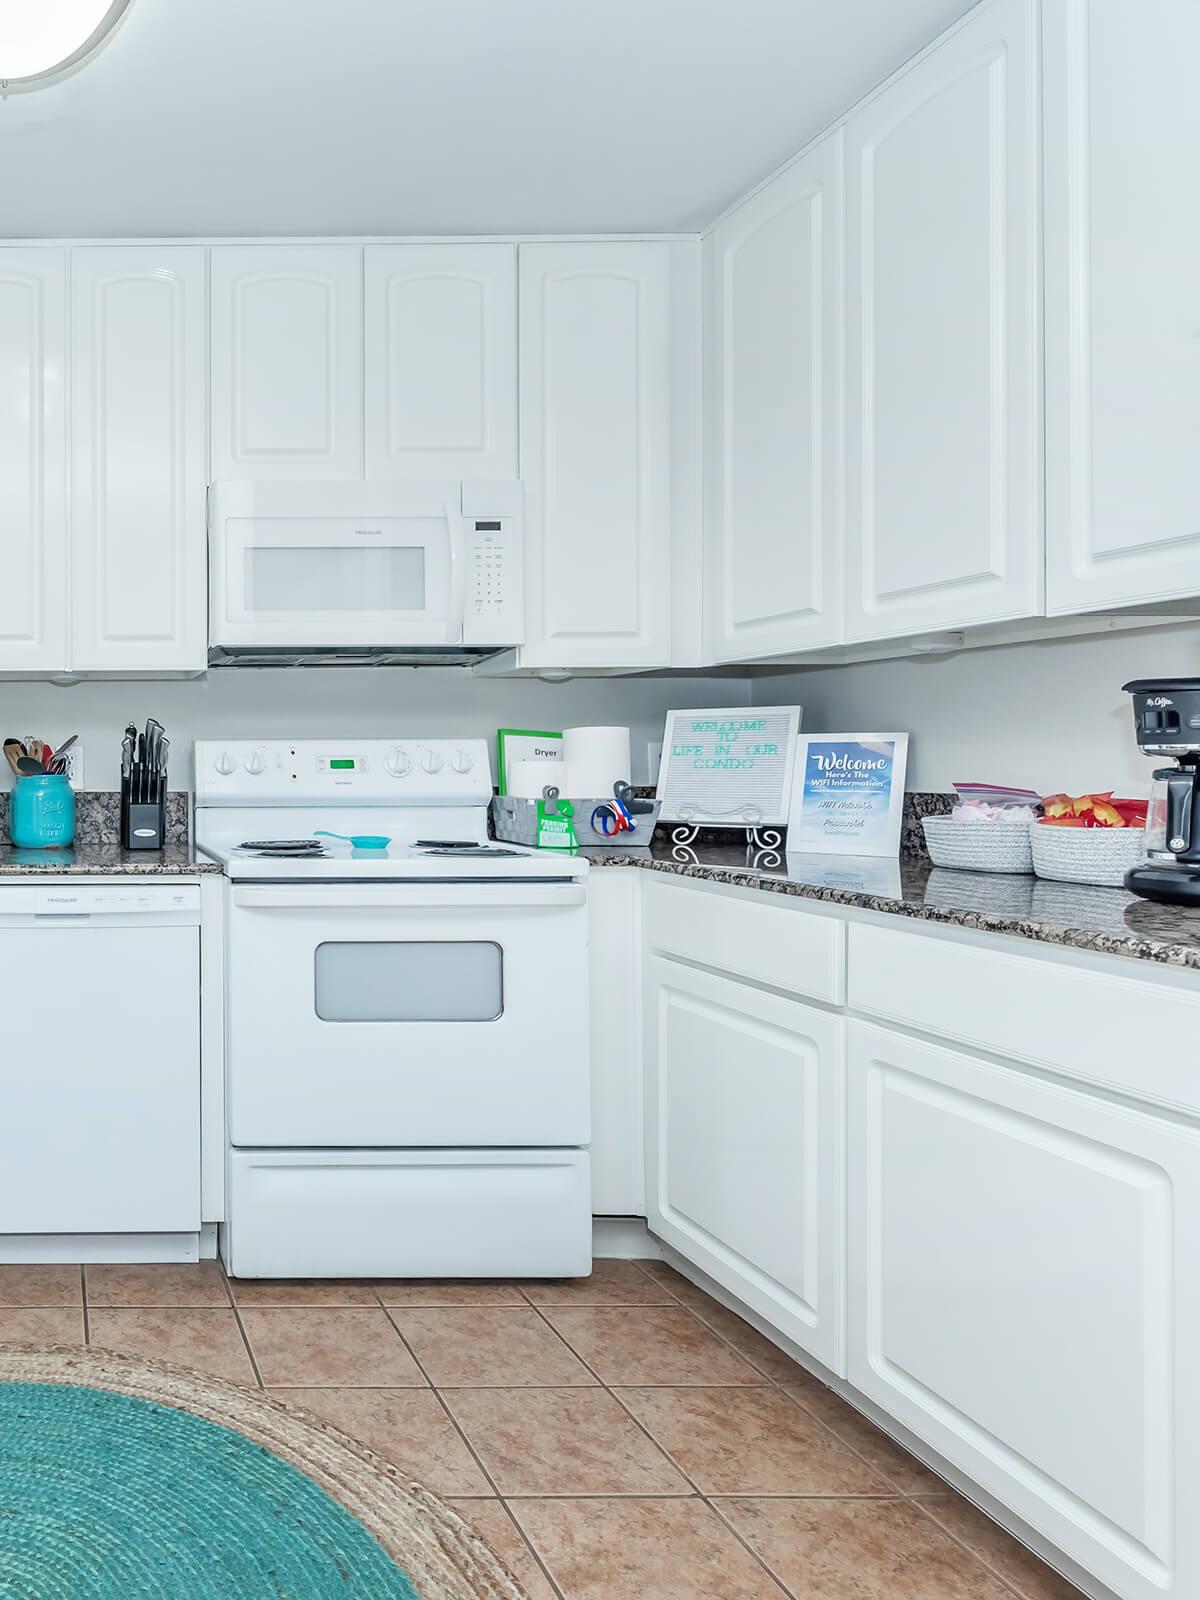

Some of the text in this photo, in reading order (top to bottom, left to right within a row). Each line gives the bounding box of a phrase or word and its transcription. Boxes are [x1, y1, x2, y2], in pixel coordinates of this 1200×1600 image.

[1155, 697, 1174, 708] Coffee
[692, 721, 767, 732] WELCOME
[718, 731, 738, 742] TO
[535, 748, 558, 757] Dryer
[671, 744, 778, 756] LIFE IN OUR
[693, 758, 754, 769] CONDO
[811, 752, 888, 771] Welcome
[831, 779, 884, 787] Information
